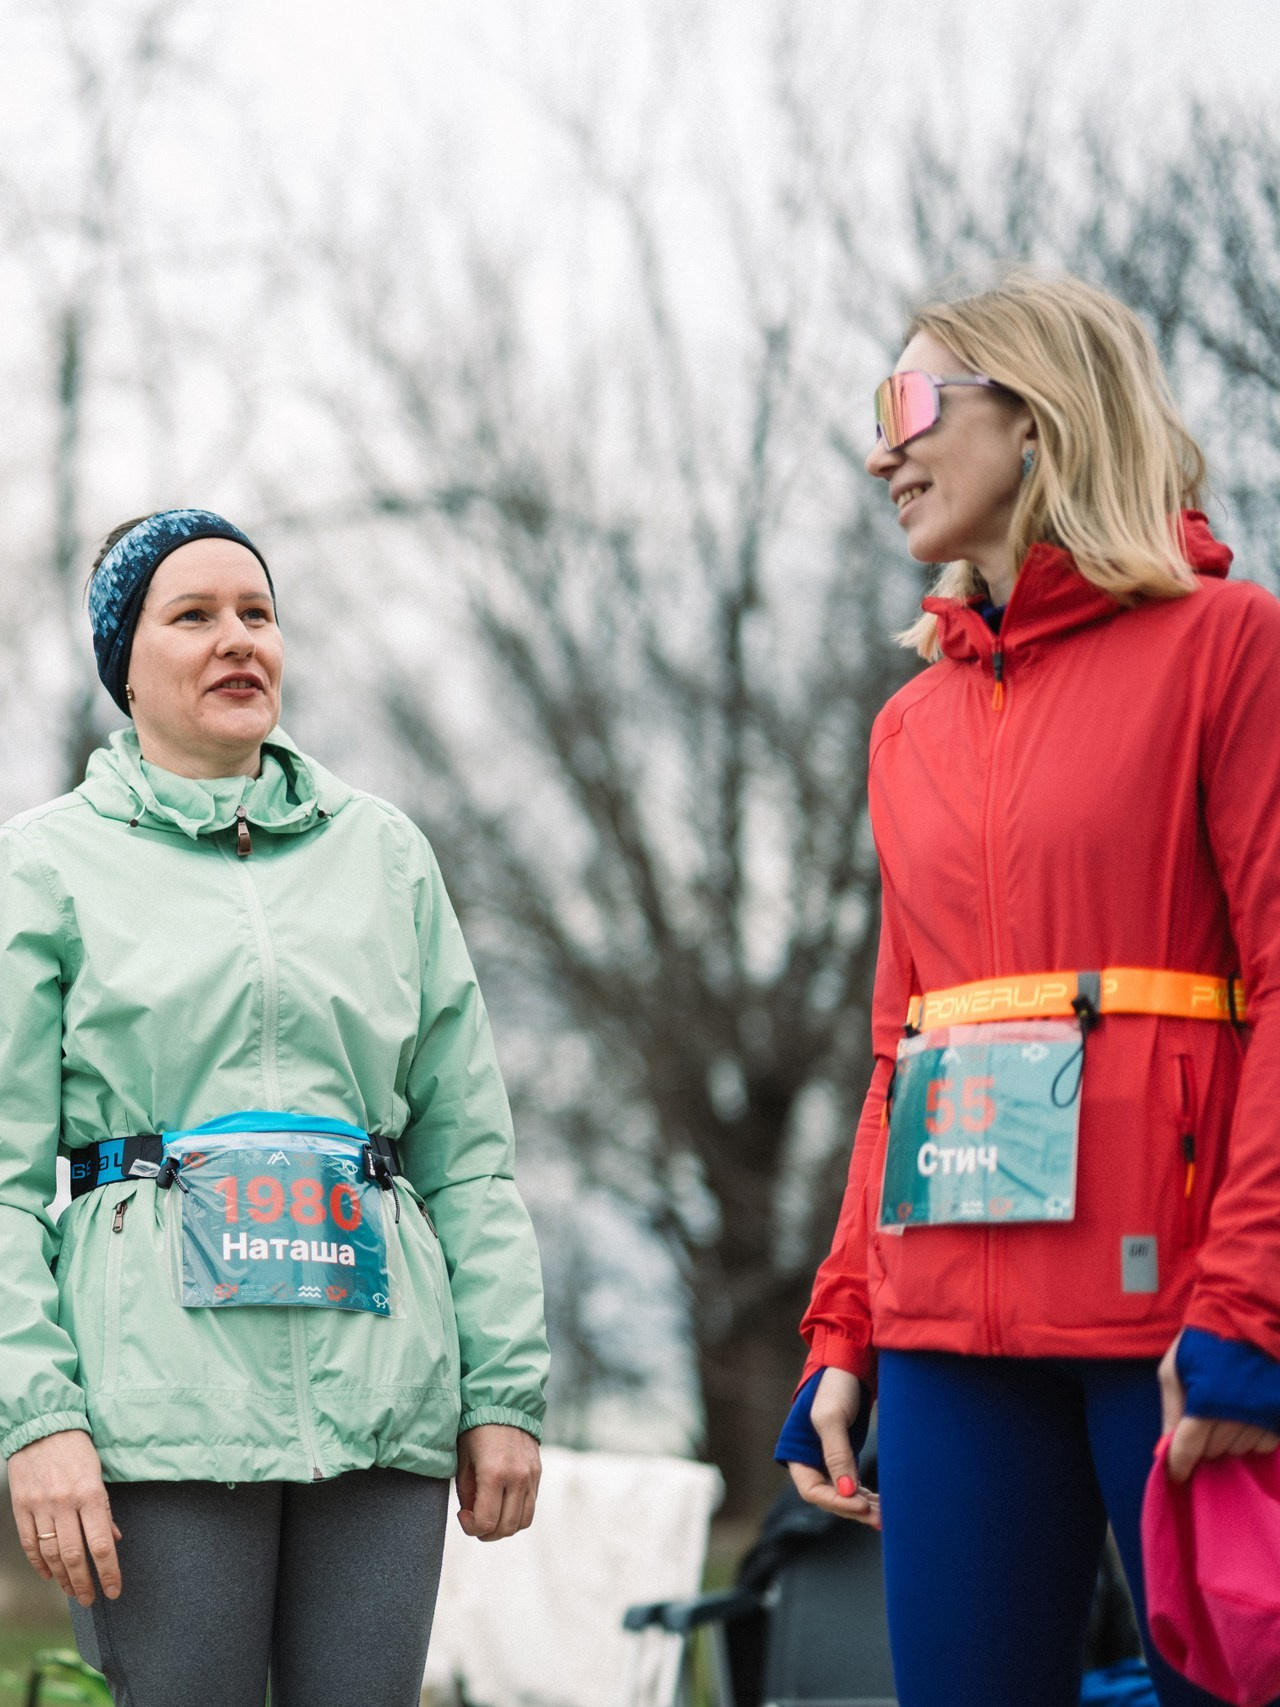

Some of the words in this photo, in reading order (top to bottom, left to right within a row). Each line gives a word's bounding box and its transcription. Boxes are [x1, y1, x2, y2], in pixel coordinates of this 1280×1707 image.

[925, 983, 1068, 1021] POWERUP
[924, 1076, 996, 1136] 55
[916, 1143, 998, 1177] Стич
[215, 1176, 362, 1231] 1980
[223, 1232, 355, 1266] Наташа
